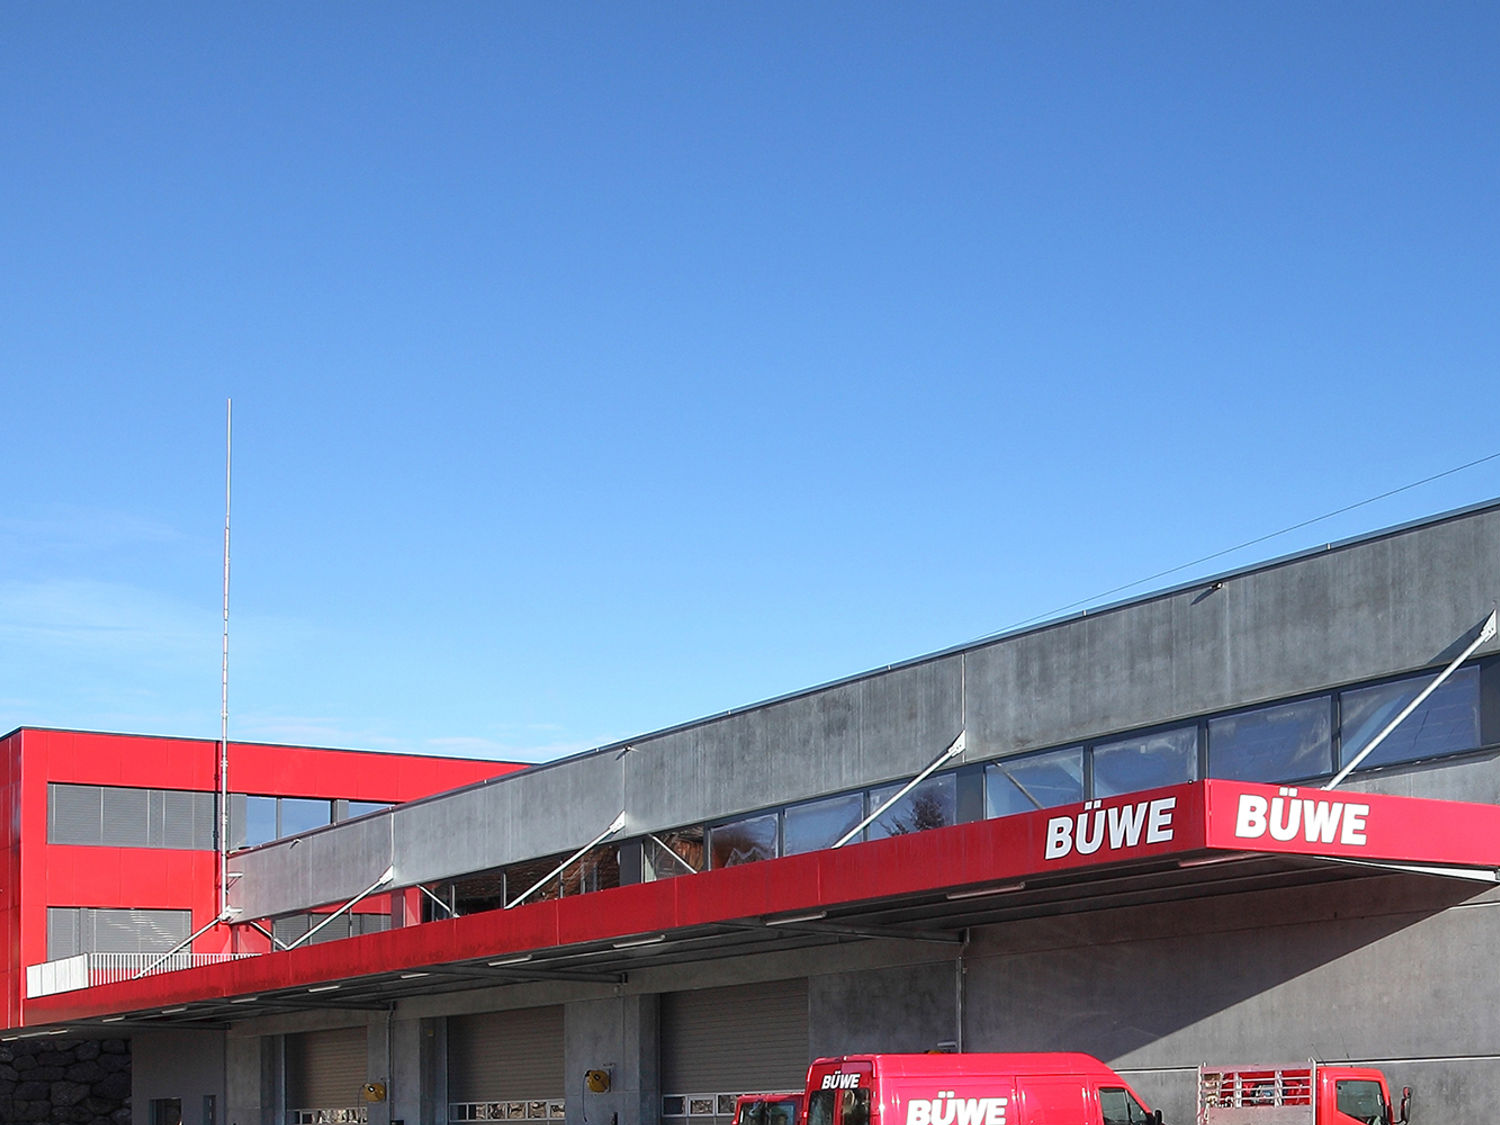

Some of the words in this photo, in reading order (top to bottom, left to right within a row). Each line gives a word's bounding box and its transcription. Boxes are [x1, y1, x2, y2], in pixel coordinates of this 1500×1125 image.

[1045, 797, 1177, 860] BÜWE
[1235, 788, 1370, 846] BÜWE
[821, 1071, 861, 1090] BÜWE
